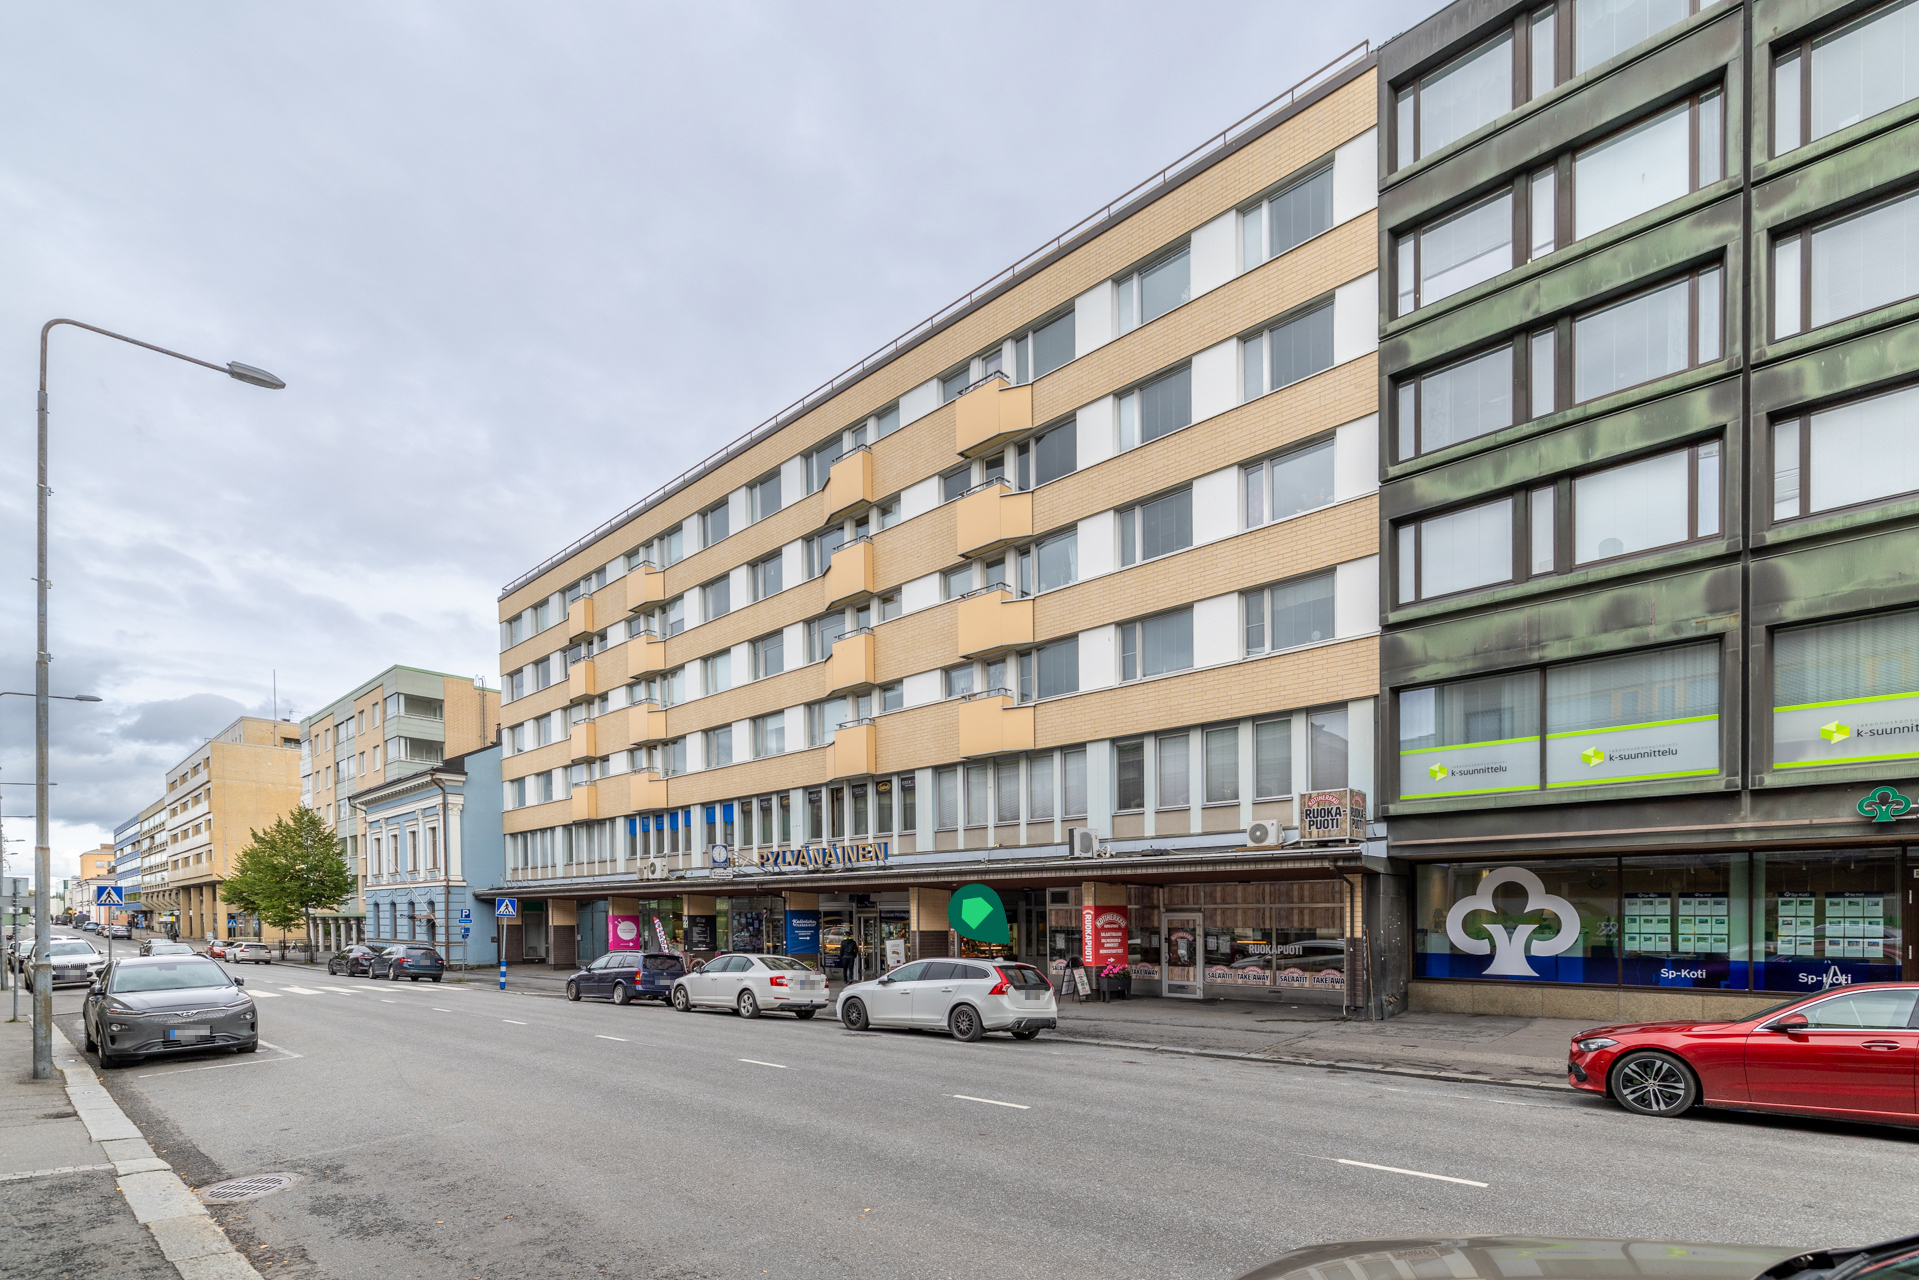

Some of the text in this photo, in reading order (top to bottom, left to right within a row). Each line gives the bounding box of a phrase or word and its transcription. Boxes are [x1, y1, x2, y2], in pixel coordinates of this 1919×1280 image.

[1857, 718, 1919, 728] rakennuskonsu
[1857, 723, 1919, 738] k-suunnit
[1609, 748, 1678, 762] k-suunnittelu
[1451, 765, 1508, 777] k-suunnittelu
[1305, 806, 1347, 820] RUOKA-
[1308, 818, 1340, 831] PUOTI
[758, 842, 888, 868] PYLVÄNÄINEN
[1085, 914, 1093, 962] RUOKAPUOTI
[1248, 944, 1303, 955] RUOKAPUOTI
[1280, 975, 1308, 983] SALAATIT
[1660, 968, 1706, 979] Sp-Koti
[1797, 972, 1852, 985] Sp-Koti
[1312, 976, 1345, 985] TAKE AWA
